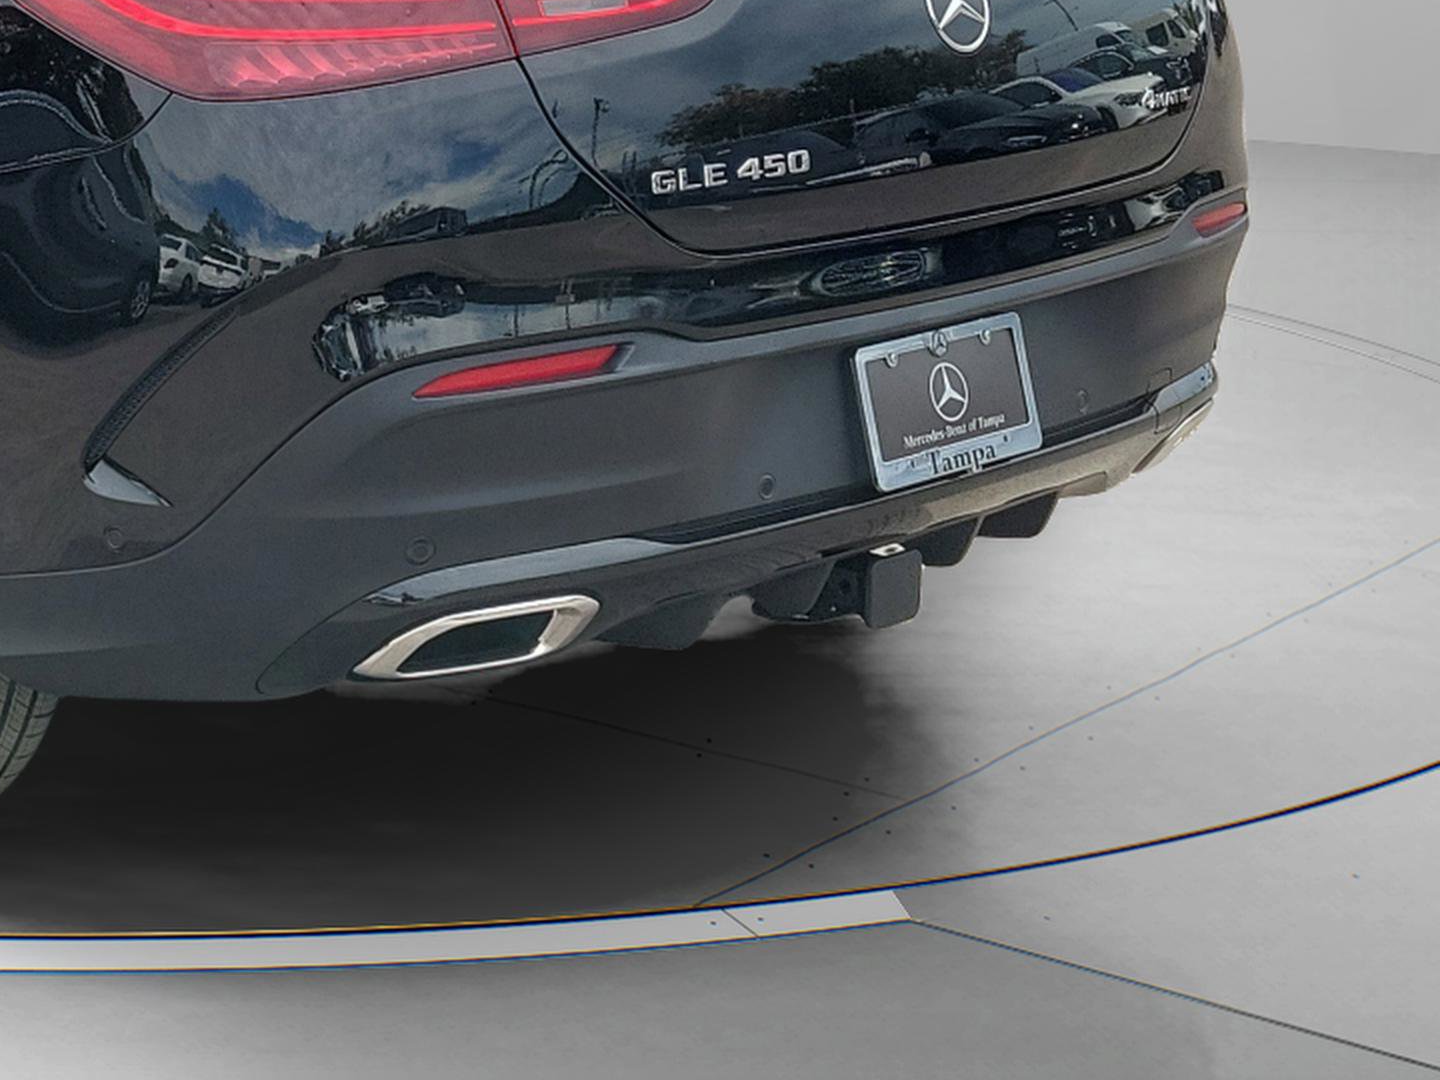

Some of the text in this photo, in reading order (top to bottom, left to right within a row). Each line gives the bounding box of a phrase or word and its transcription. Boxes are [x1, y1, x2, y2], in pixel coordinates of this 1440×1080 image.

[651, 149, 811, 195] GLE 450
[903, 414, 1005, 449] Mercedes-Benz of Tampa
[925, 445, 997, 473] Tampa
